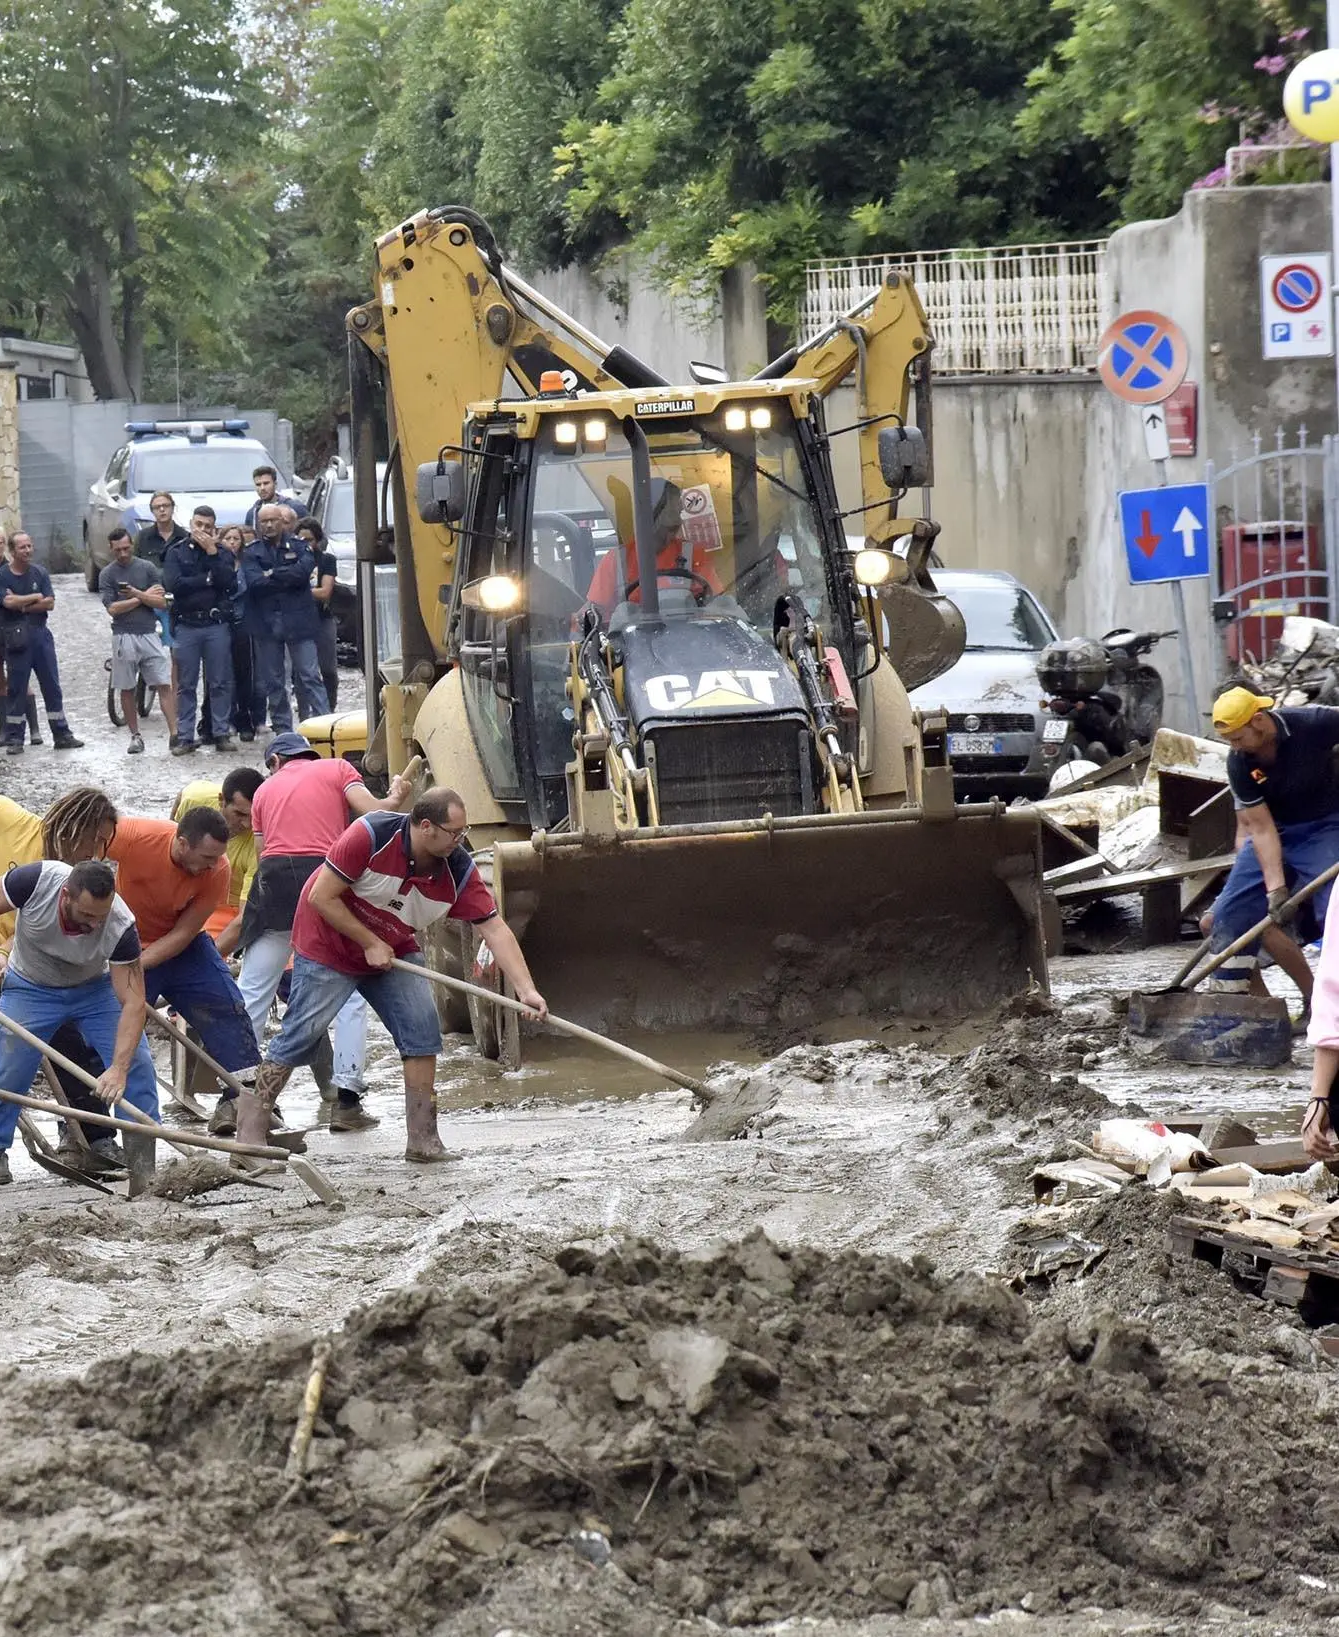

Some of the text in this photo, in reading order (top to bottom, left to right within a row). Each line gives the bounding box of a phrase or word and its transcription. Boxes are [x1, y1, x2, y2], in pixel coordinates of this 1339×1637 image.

[1274, 325, 1288, 340] P
[637, 400, 694, 414] CATERPILLAR
[645, 670, 780, 711] CAT
